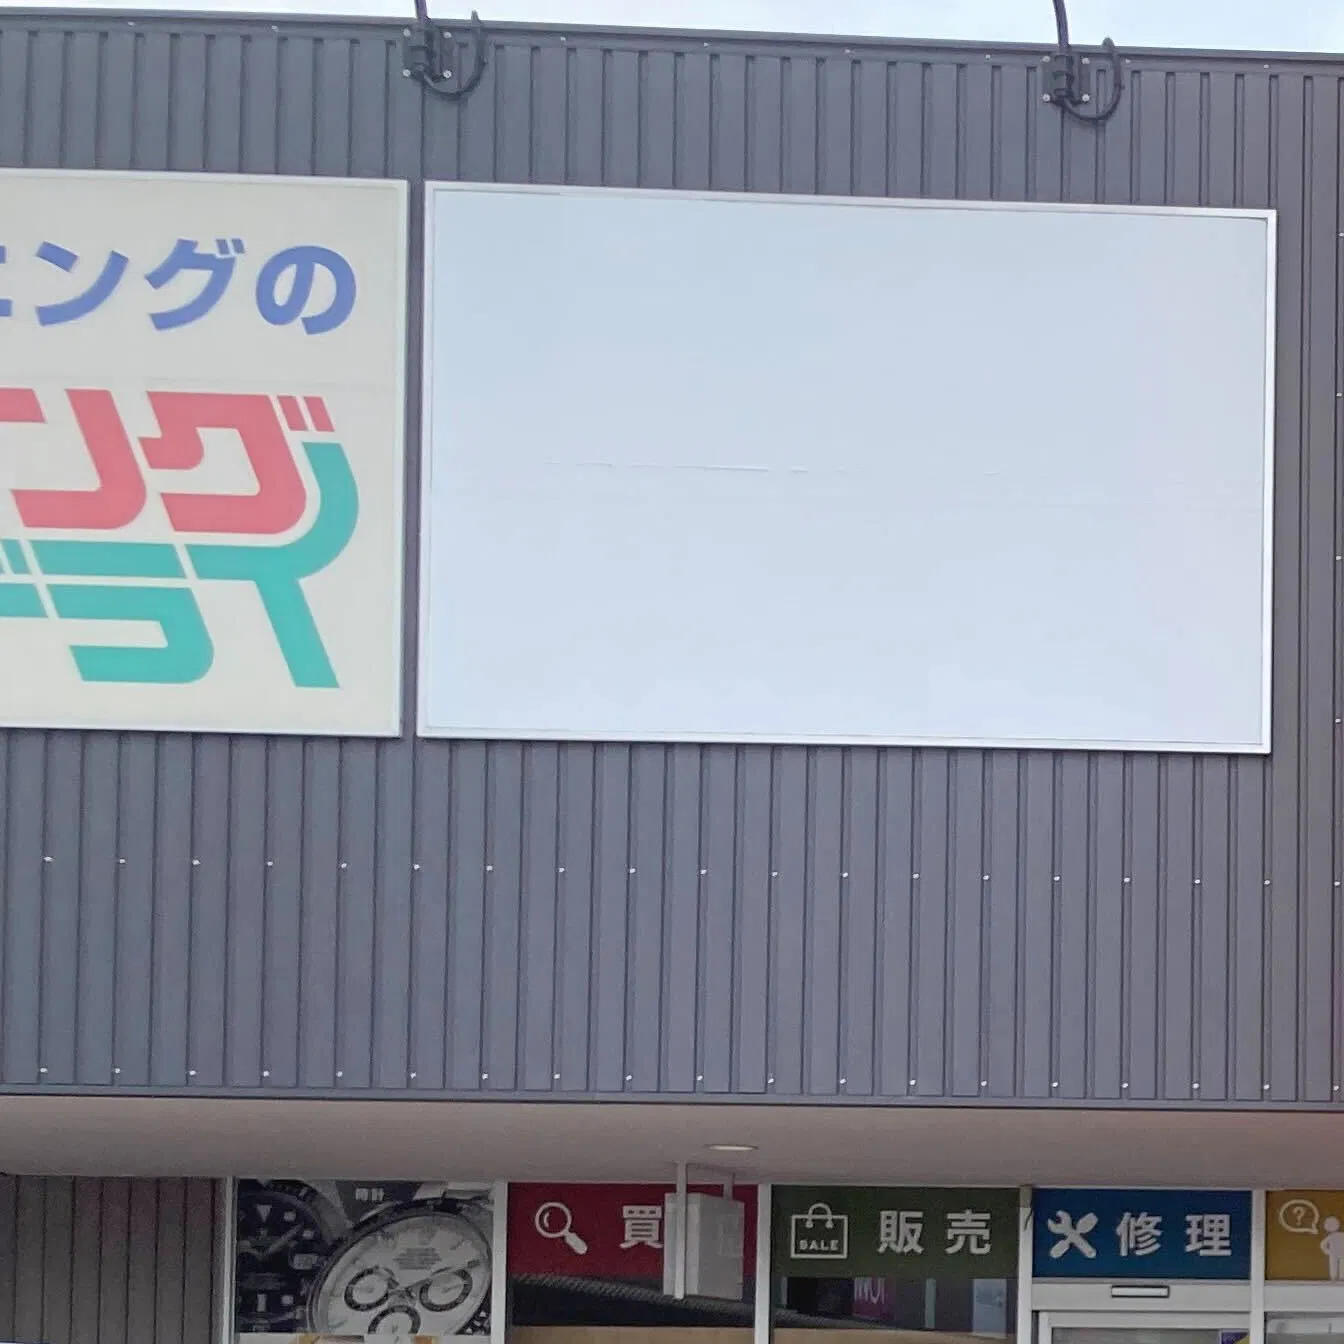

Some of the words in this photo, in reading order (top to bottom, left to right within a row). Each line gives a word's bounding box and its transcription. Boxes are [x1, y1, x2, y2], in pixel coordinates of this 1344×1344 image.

[0, 238, 357, 335] ングの
[799, 1239, 839, 1251] SALE
[878, 1209, 992, 1255] 販売
[1115, 1211, 1232, 1257] 修理
